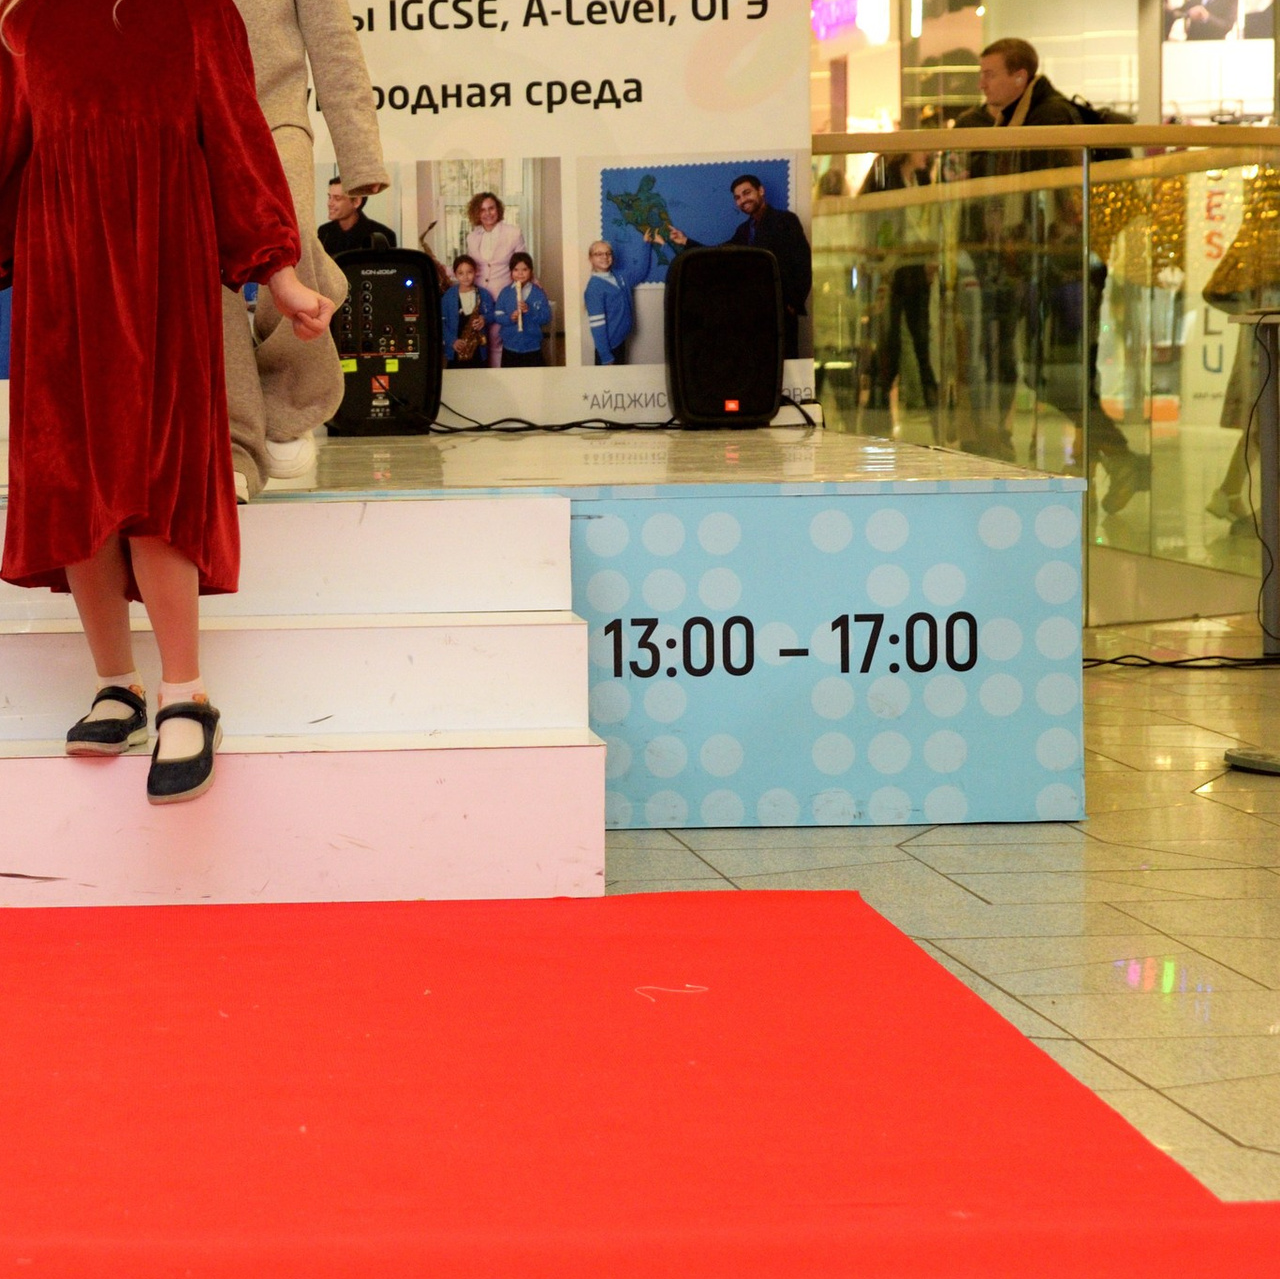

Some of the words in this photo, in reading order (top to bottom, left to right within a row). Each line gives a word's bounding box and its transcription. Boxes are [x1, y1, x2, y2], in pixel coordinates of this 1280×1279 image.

[525, 78, 643, 114] среда
[604, 615, 755, 679] 13:00
[830, 611, 979, 674] 17:00
